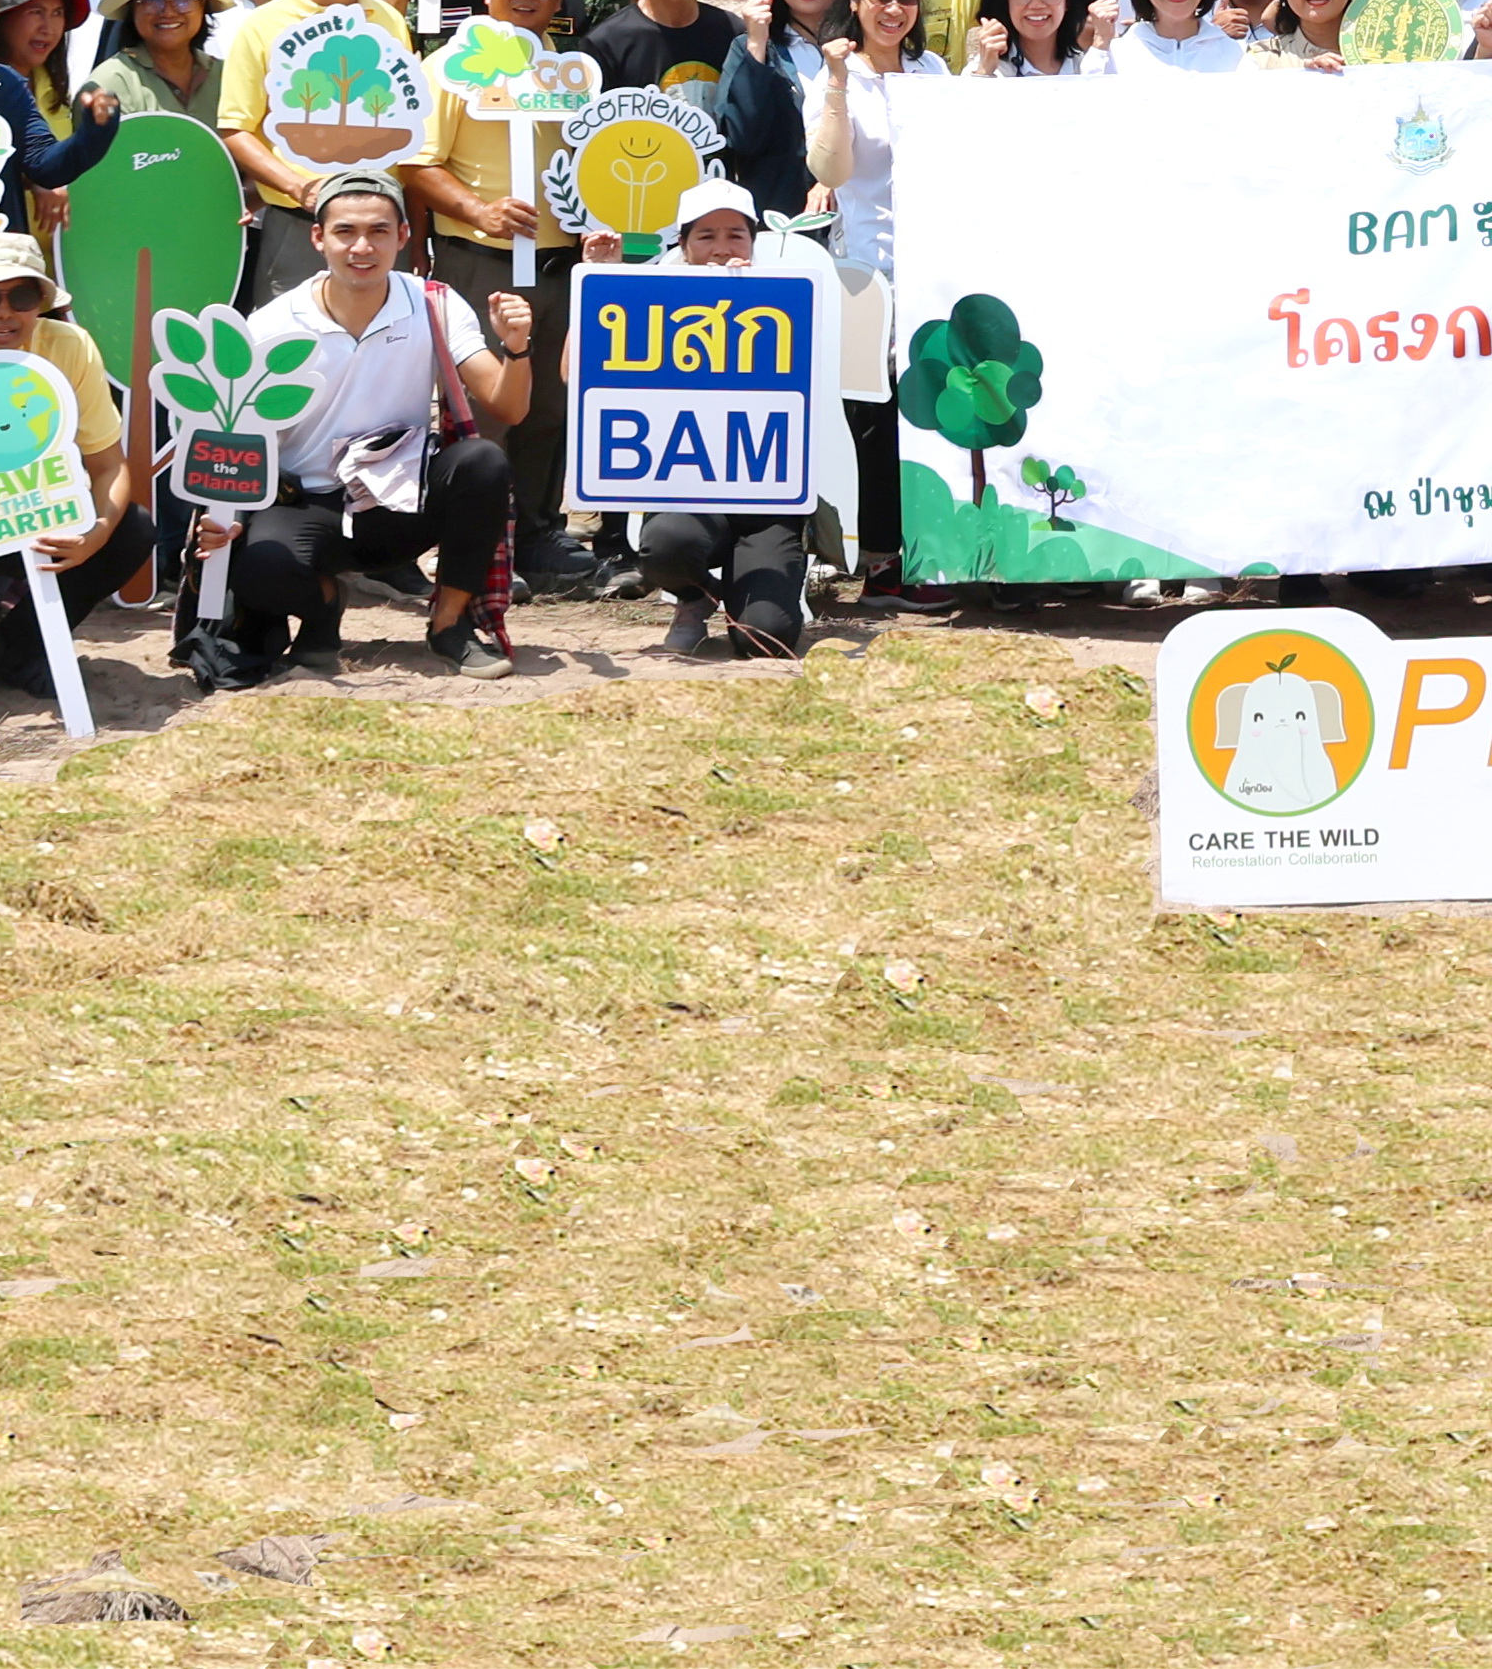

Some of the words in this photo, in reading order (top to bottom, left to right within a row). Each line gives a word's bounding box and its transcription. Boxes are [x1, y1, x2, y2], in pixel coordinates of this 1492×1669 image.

[279, 15, 343, 58] Plant
[388, 58, 420, 111] Tree
[532, 58, 594, 92] GO
[517, 92, 591, 111] GREEN
[131, 146, 181, 170] Bam
[1348, 203, 1458, 256] BAM
[598, 298, 793, 374] บสก
[192, 440, 263, 467] Save
[598, 410, 790, 483] BAM
[213, 462, 239, 475] the
[0, 490, 45, 515] THE
[1363, 489, 1397, 520] ณ
[1189, 832, 1255, 851] CARE
[1264, 830, 1311, 849] THE
[1319, 828, 1380, 847] WILD
[1192, 854, 1282, 868] Reforestation
[1288, 851, 1378, 866] Collaboration
